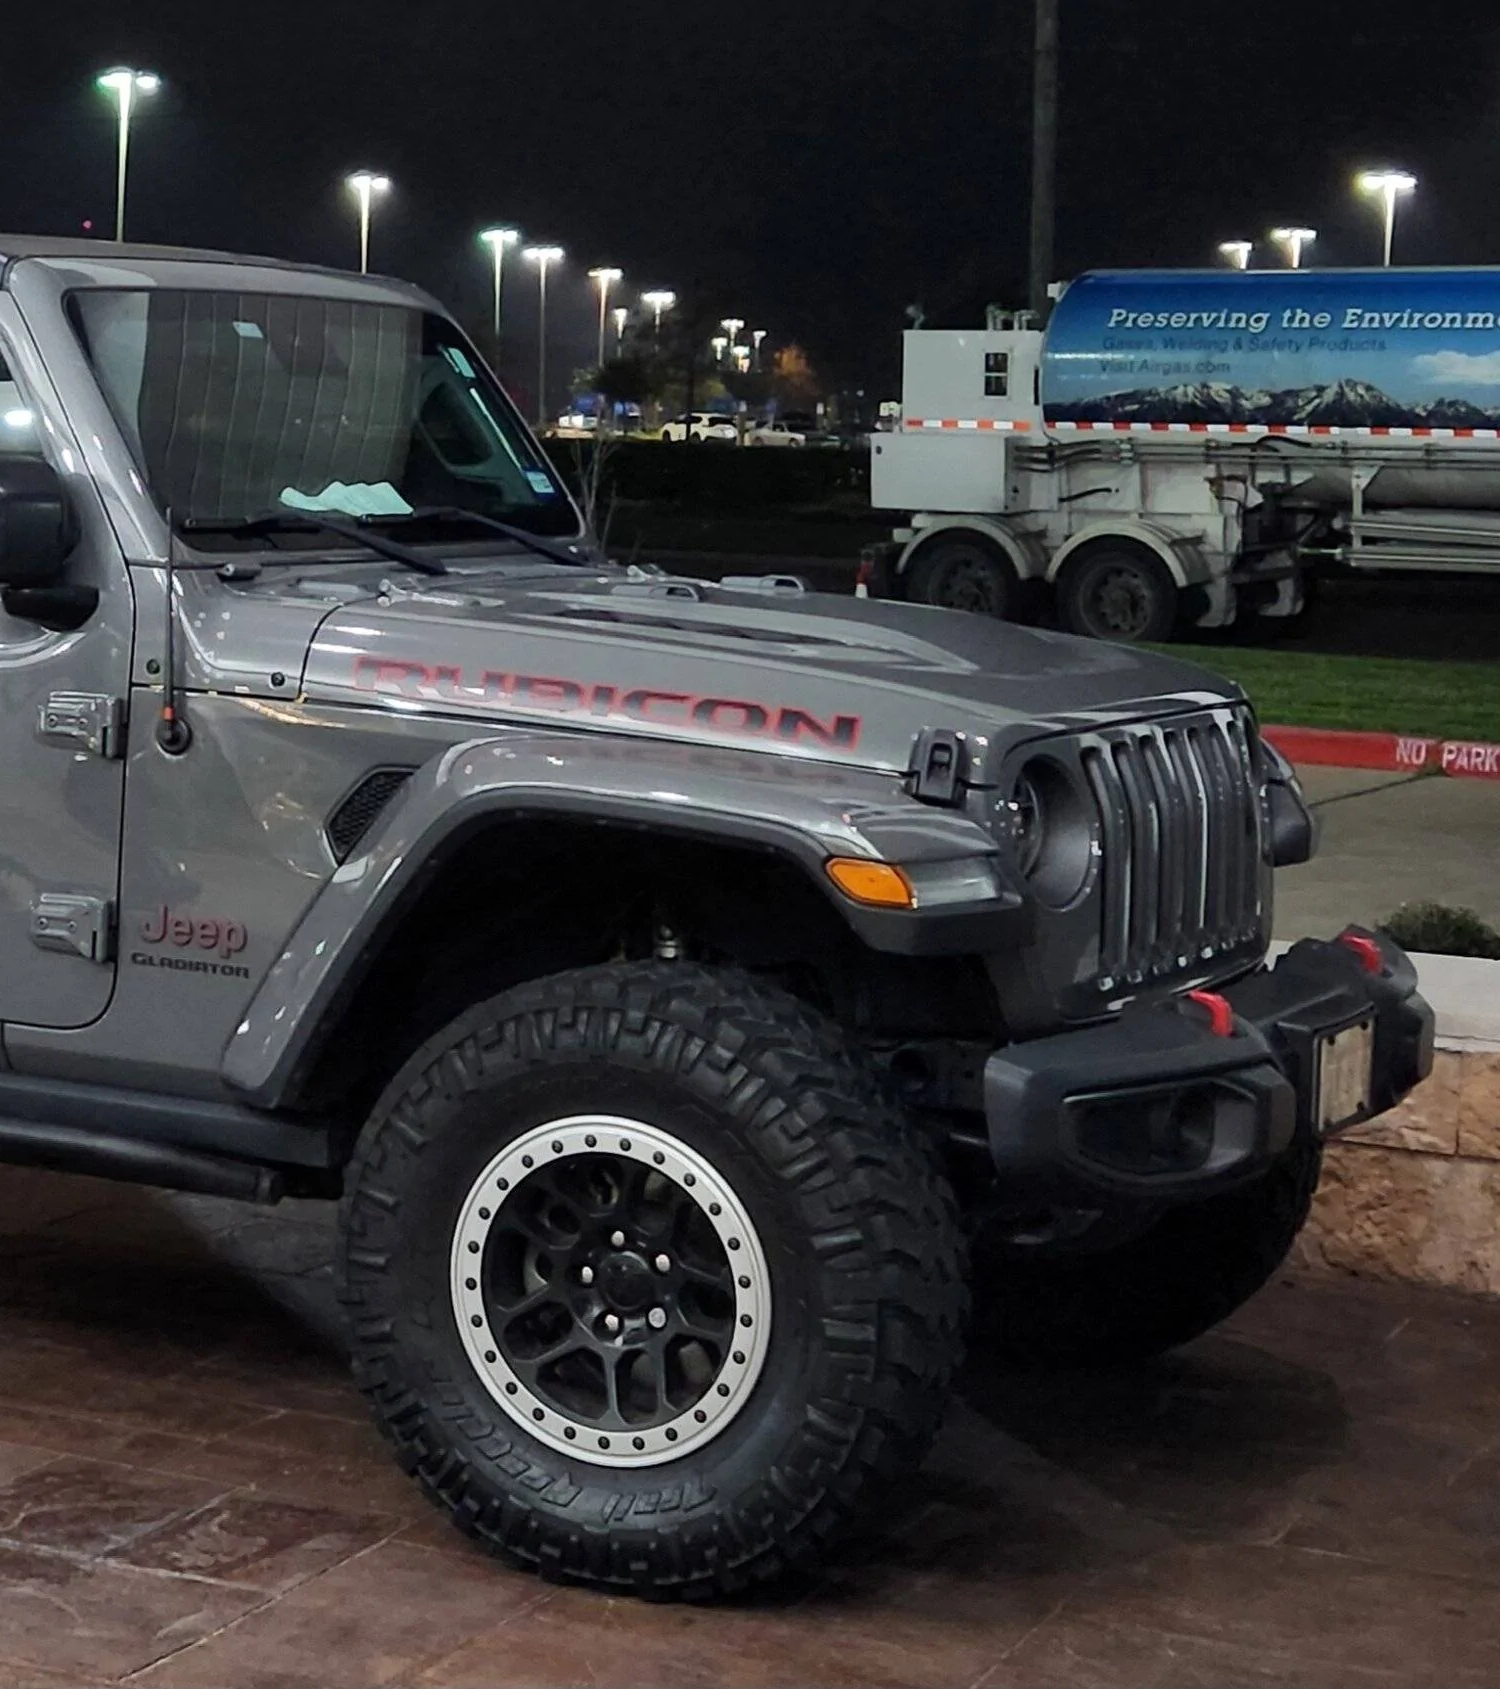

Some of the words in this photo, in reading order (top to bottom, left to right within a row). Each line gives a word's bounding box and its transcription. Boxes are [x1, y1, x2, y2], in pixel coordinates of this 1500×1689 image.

[1107, 308, 1270, 333] Preserving
[1281, 308, 1332, 329] the
[1341, 308, 1500, 329] Environm
[1162, 337, 1228, 354] Welding
[1232, 338, 1243, 351] &
[1249, 337, 1303, 354] Safety
[1308, 336, 1388, 352] Products
[1099, 359, 1135, 374] Visit
[1139, 359, 1231, 376] Airgas.com
[353, 654, 861, 752] RUBICON
[1396, 739, 1427, 765] NO
[1441, 746, 1500, 772] PARK
[140, 903, 248, 960] Jeep
[131, 952, 250, 979] GLADIATOR
